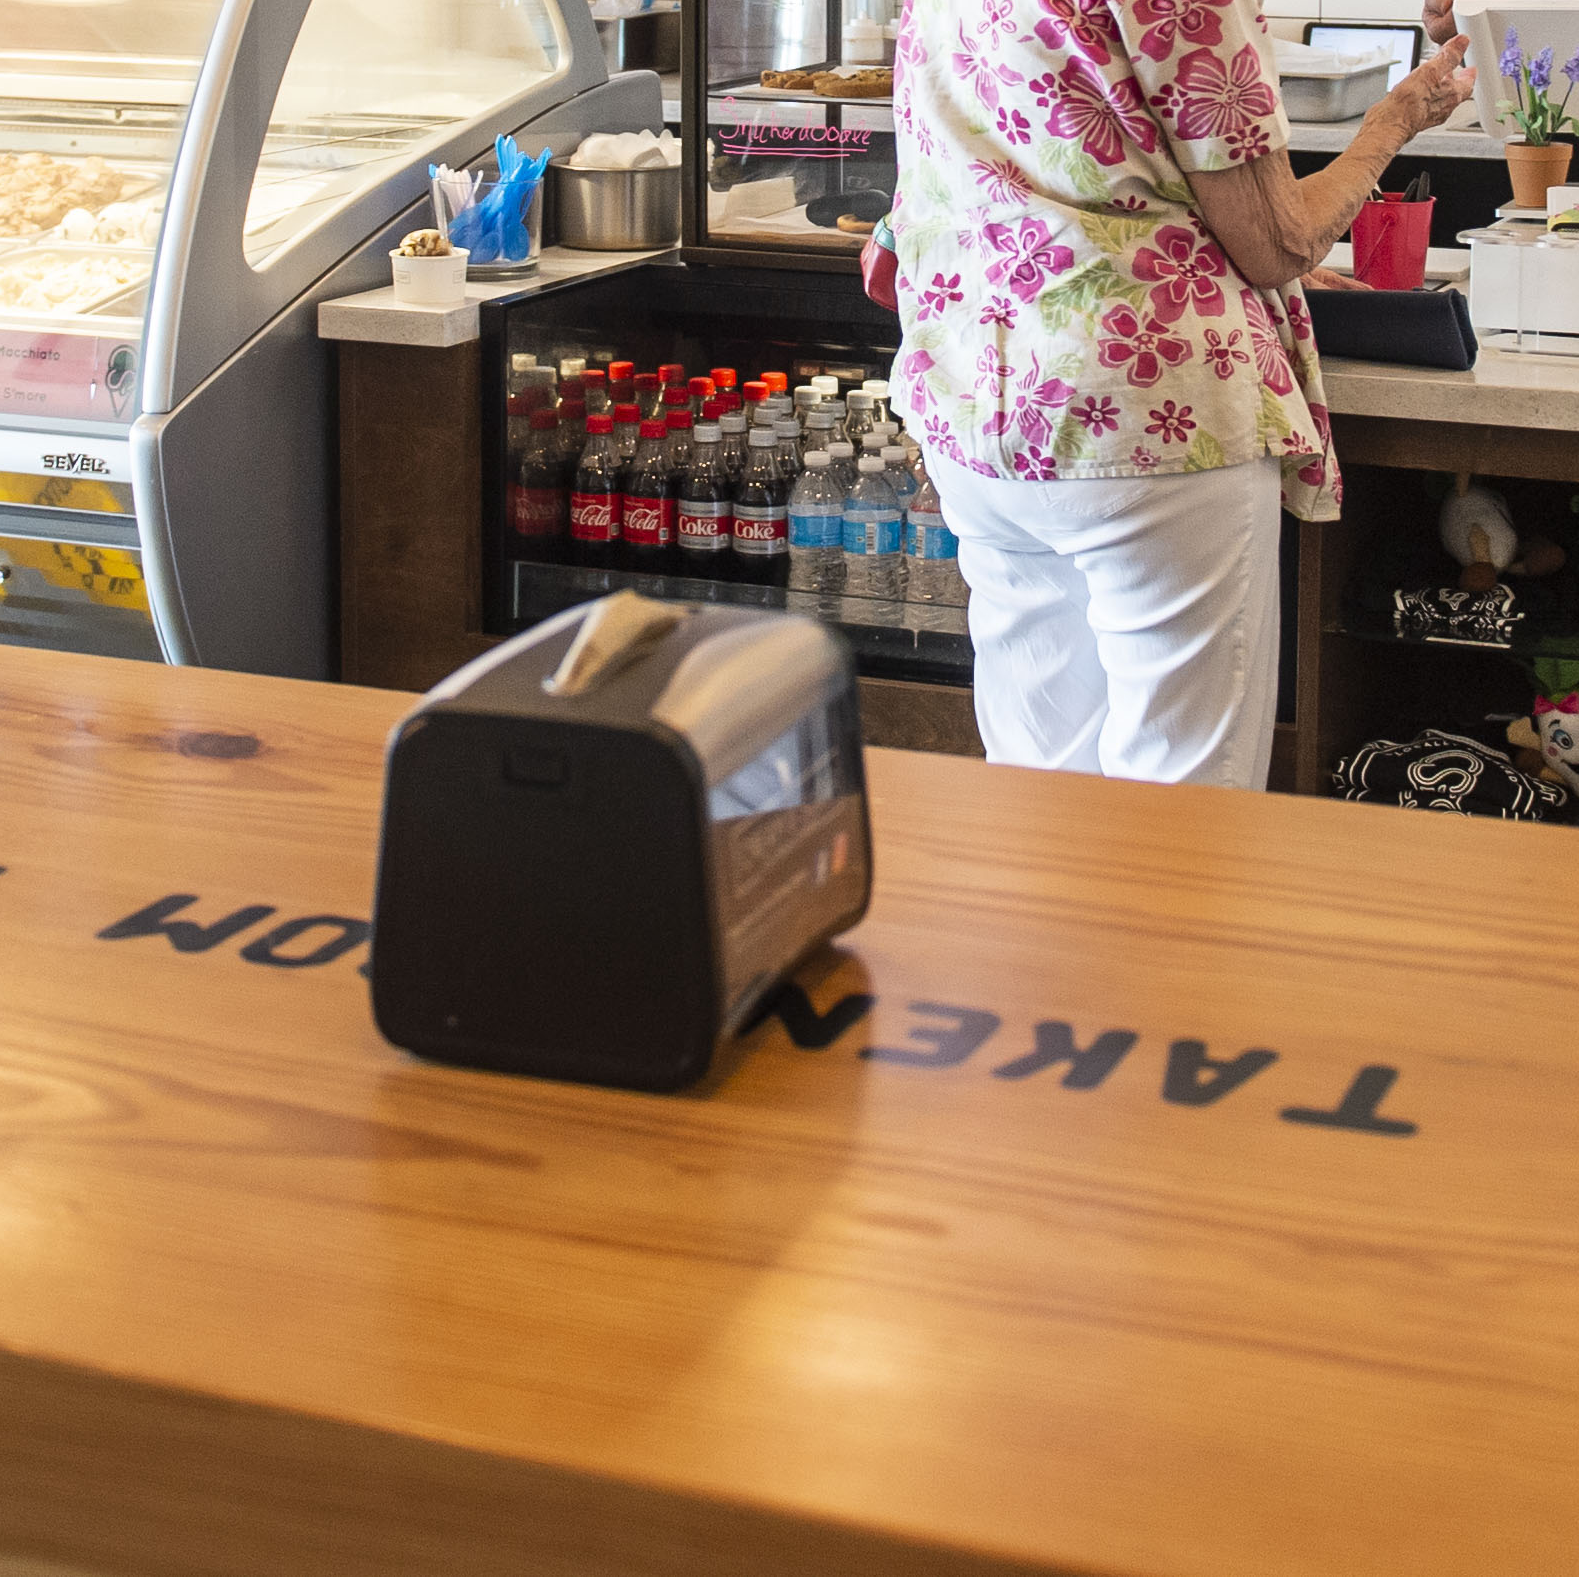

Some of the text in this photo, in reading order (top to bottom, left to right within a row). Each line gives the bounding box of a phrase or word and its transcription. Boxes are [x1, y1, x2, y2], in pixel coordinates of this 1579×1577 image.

[679, 518, 718, 535] Coke
[734, 520, 774, 540] Coke
[94, 893, 375, 982] OM
[732, 979, 1419, 1138] TAKEN
